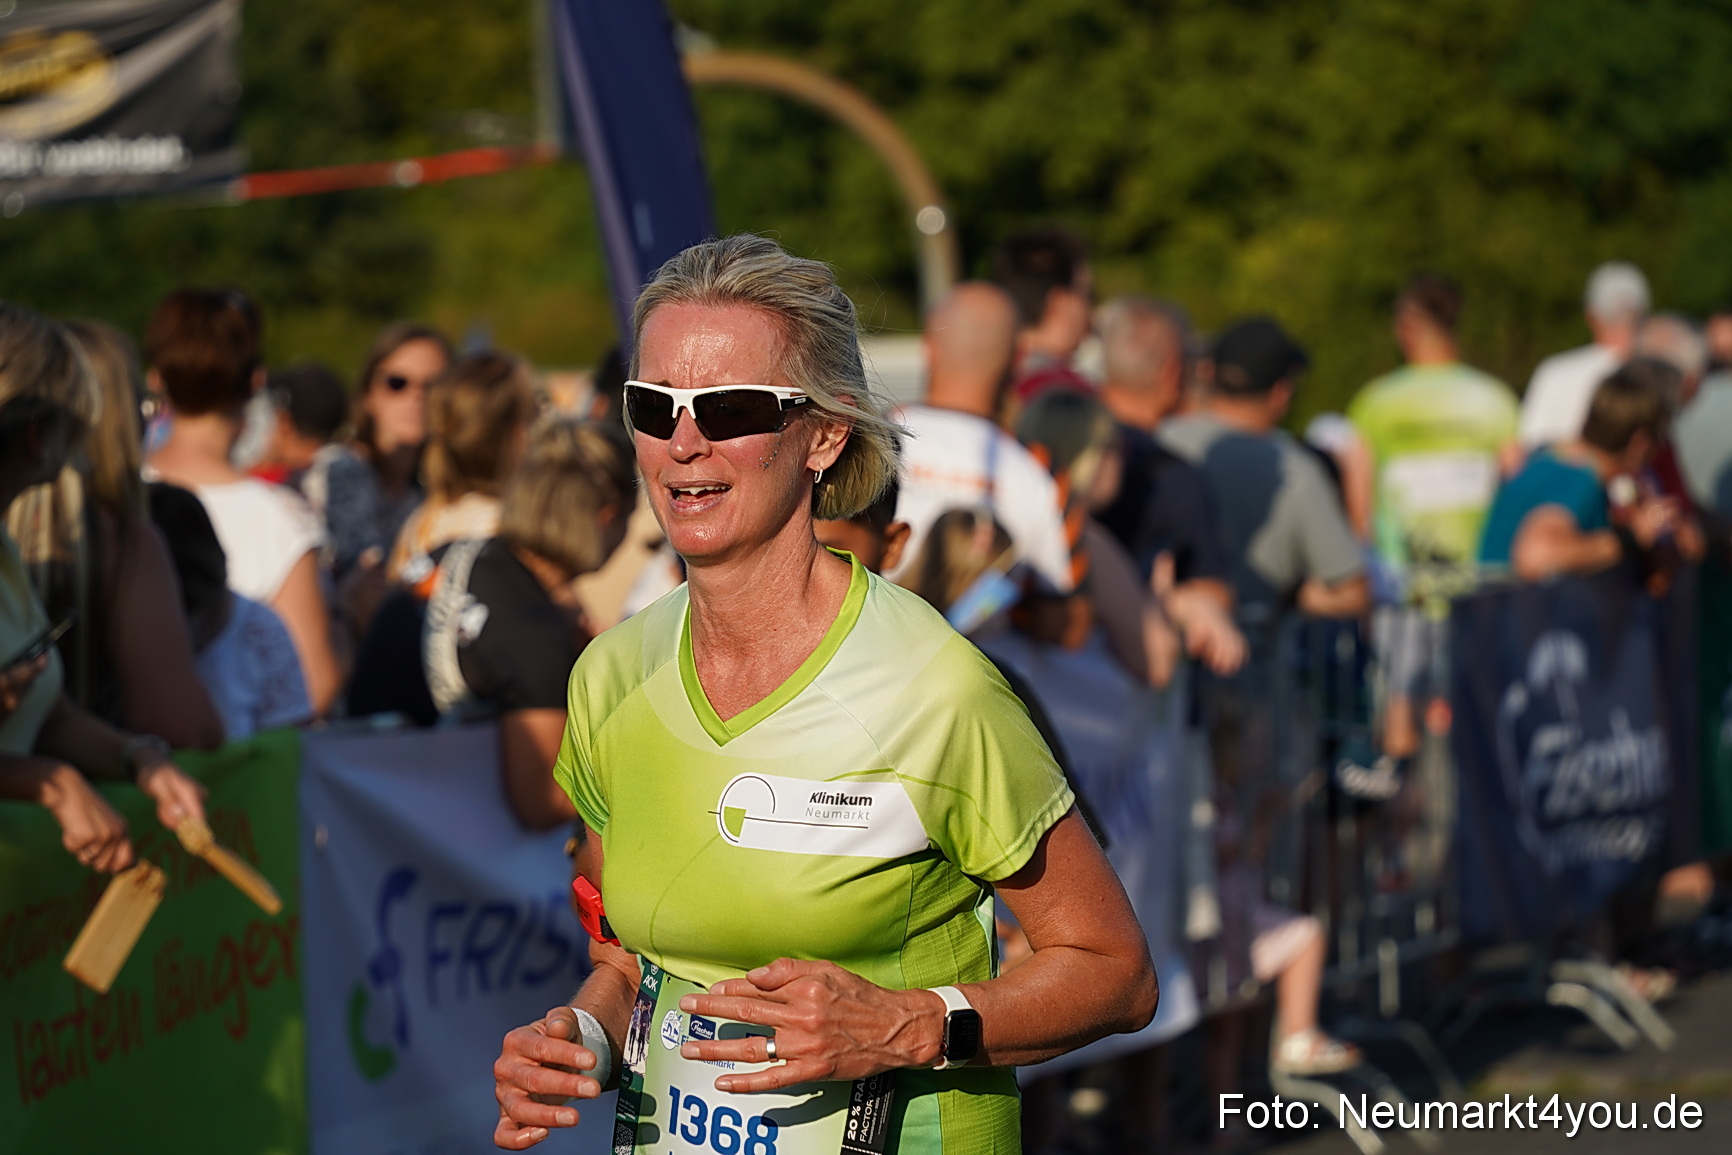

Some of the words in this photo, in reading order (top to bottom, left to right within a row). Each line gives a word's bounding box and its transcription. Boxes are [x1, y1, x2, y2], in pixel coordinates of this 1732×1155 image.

[809, 792, 873, 806] Klinikum
[805, 808, 870, 820] Neumarkt
[642, 975, 659, 992] AOK
[851, 1105, 861, 1116] %
[860, 1091, 874, 1142] FACTORY
[669, 1085, 778, 1155] 1368
[847, 1118, 858, 1141] 20
